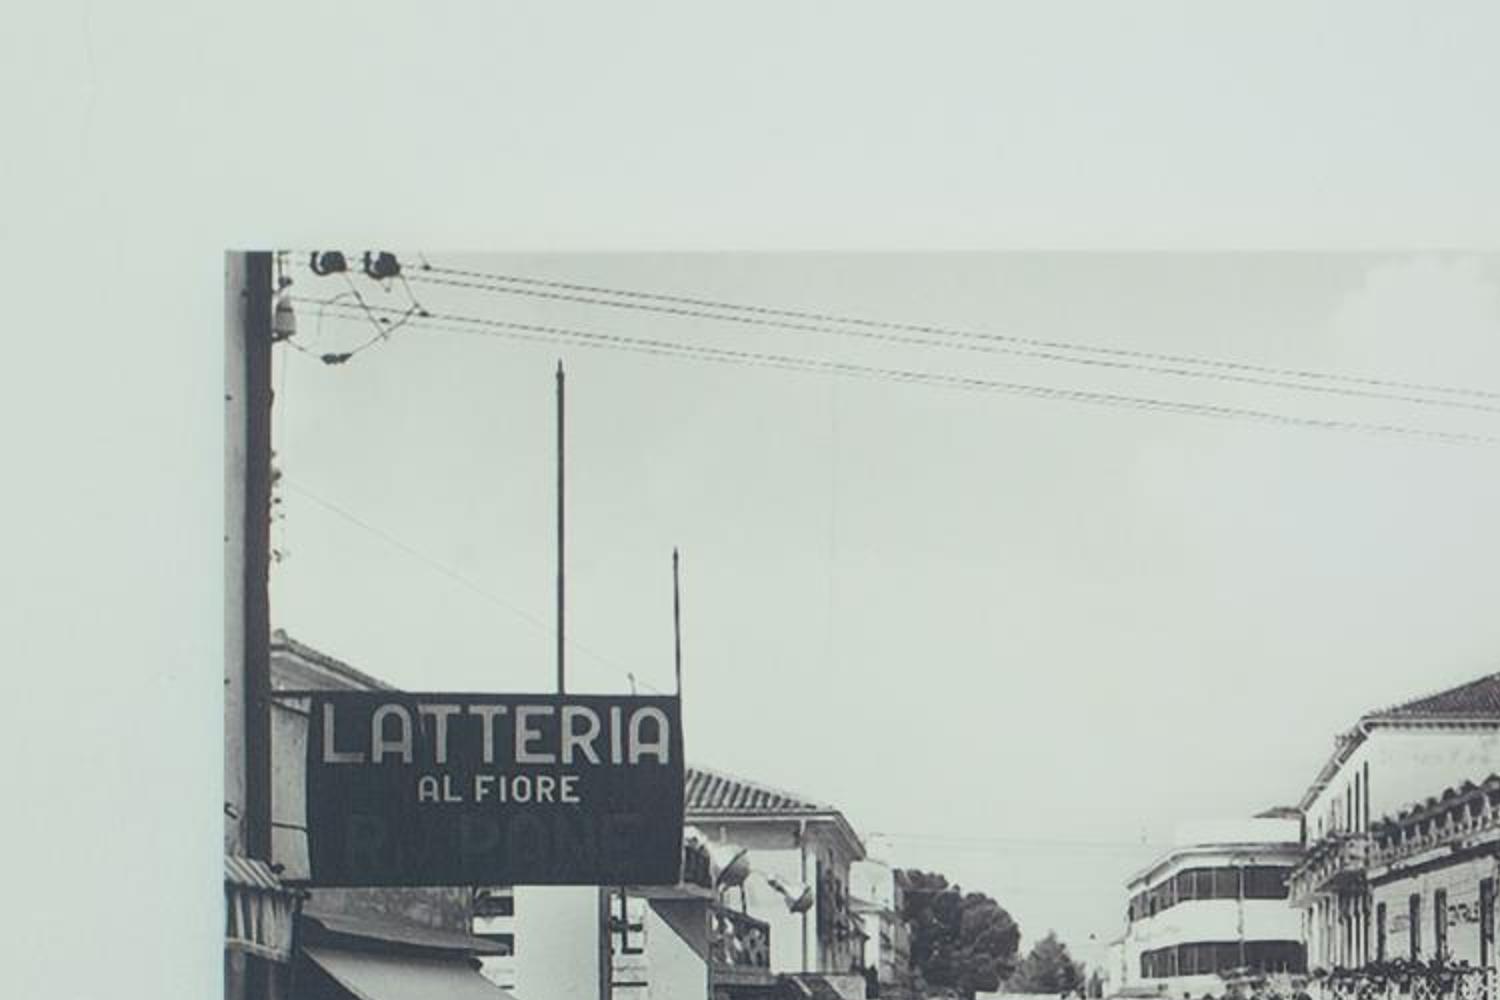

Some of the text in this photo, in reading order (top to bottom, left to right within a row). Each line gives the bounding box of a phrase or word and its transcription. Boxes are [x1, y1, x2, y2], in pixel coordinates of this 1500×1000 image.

[323, 702, 670, 764] LATTERIA
[418, 775, 580, 803] AL FIORE
